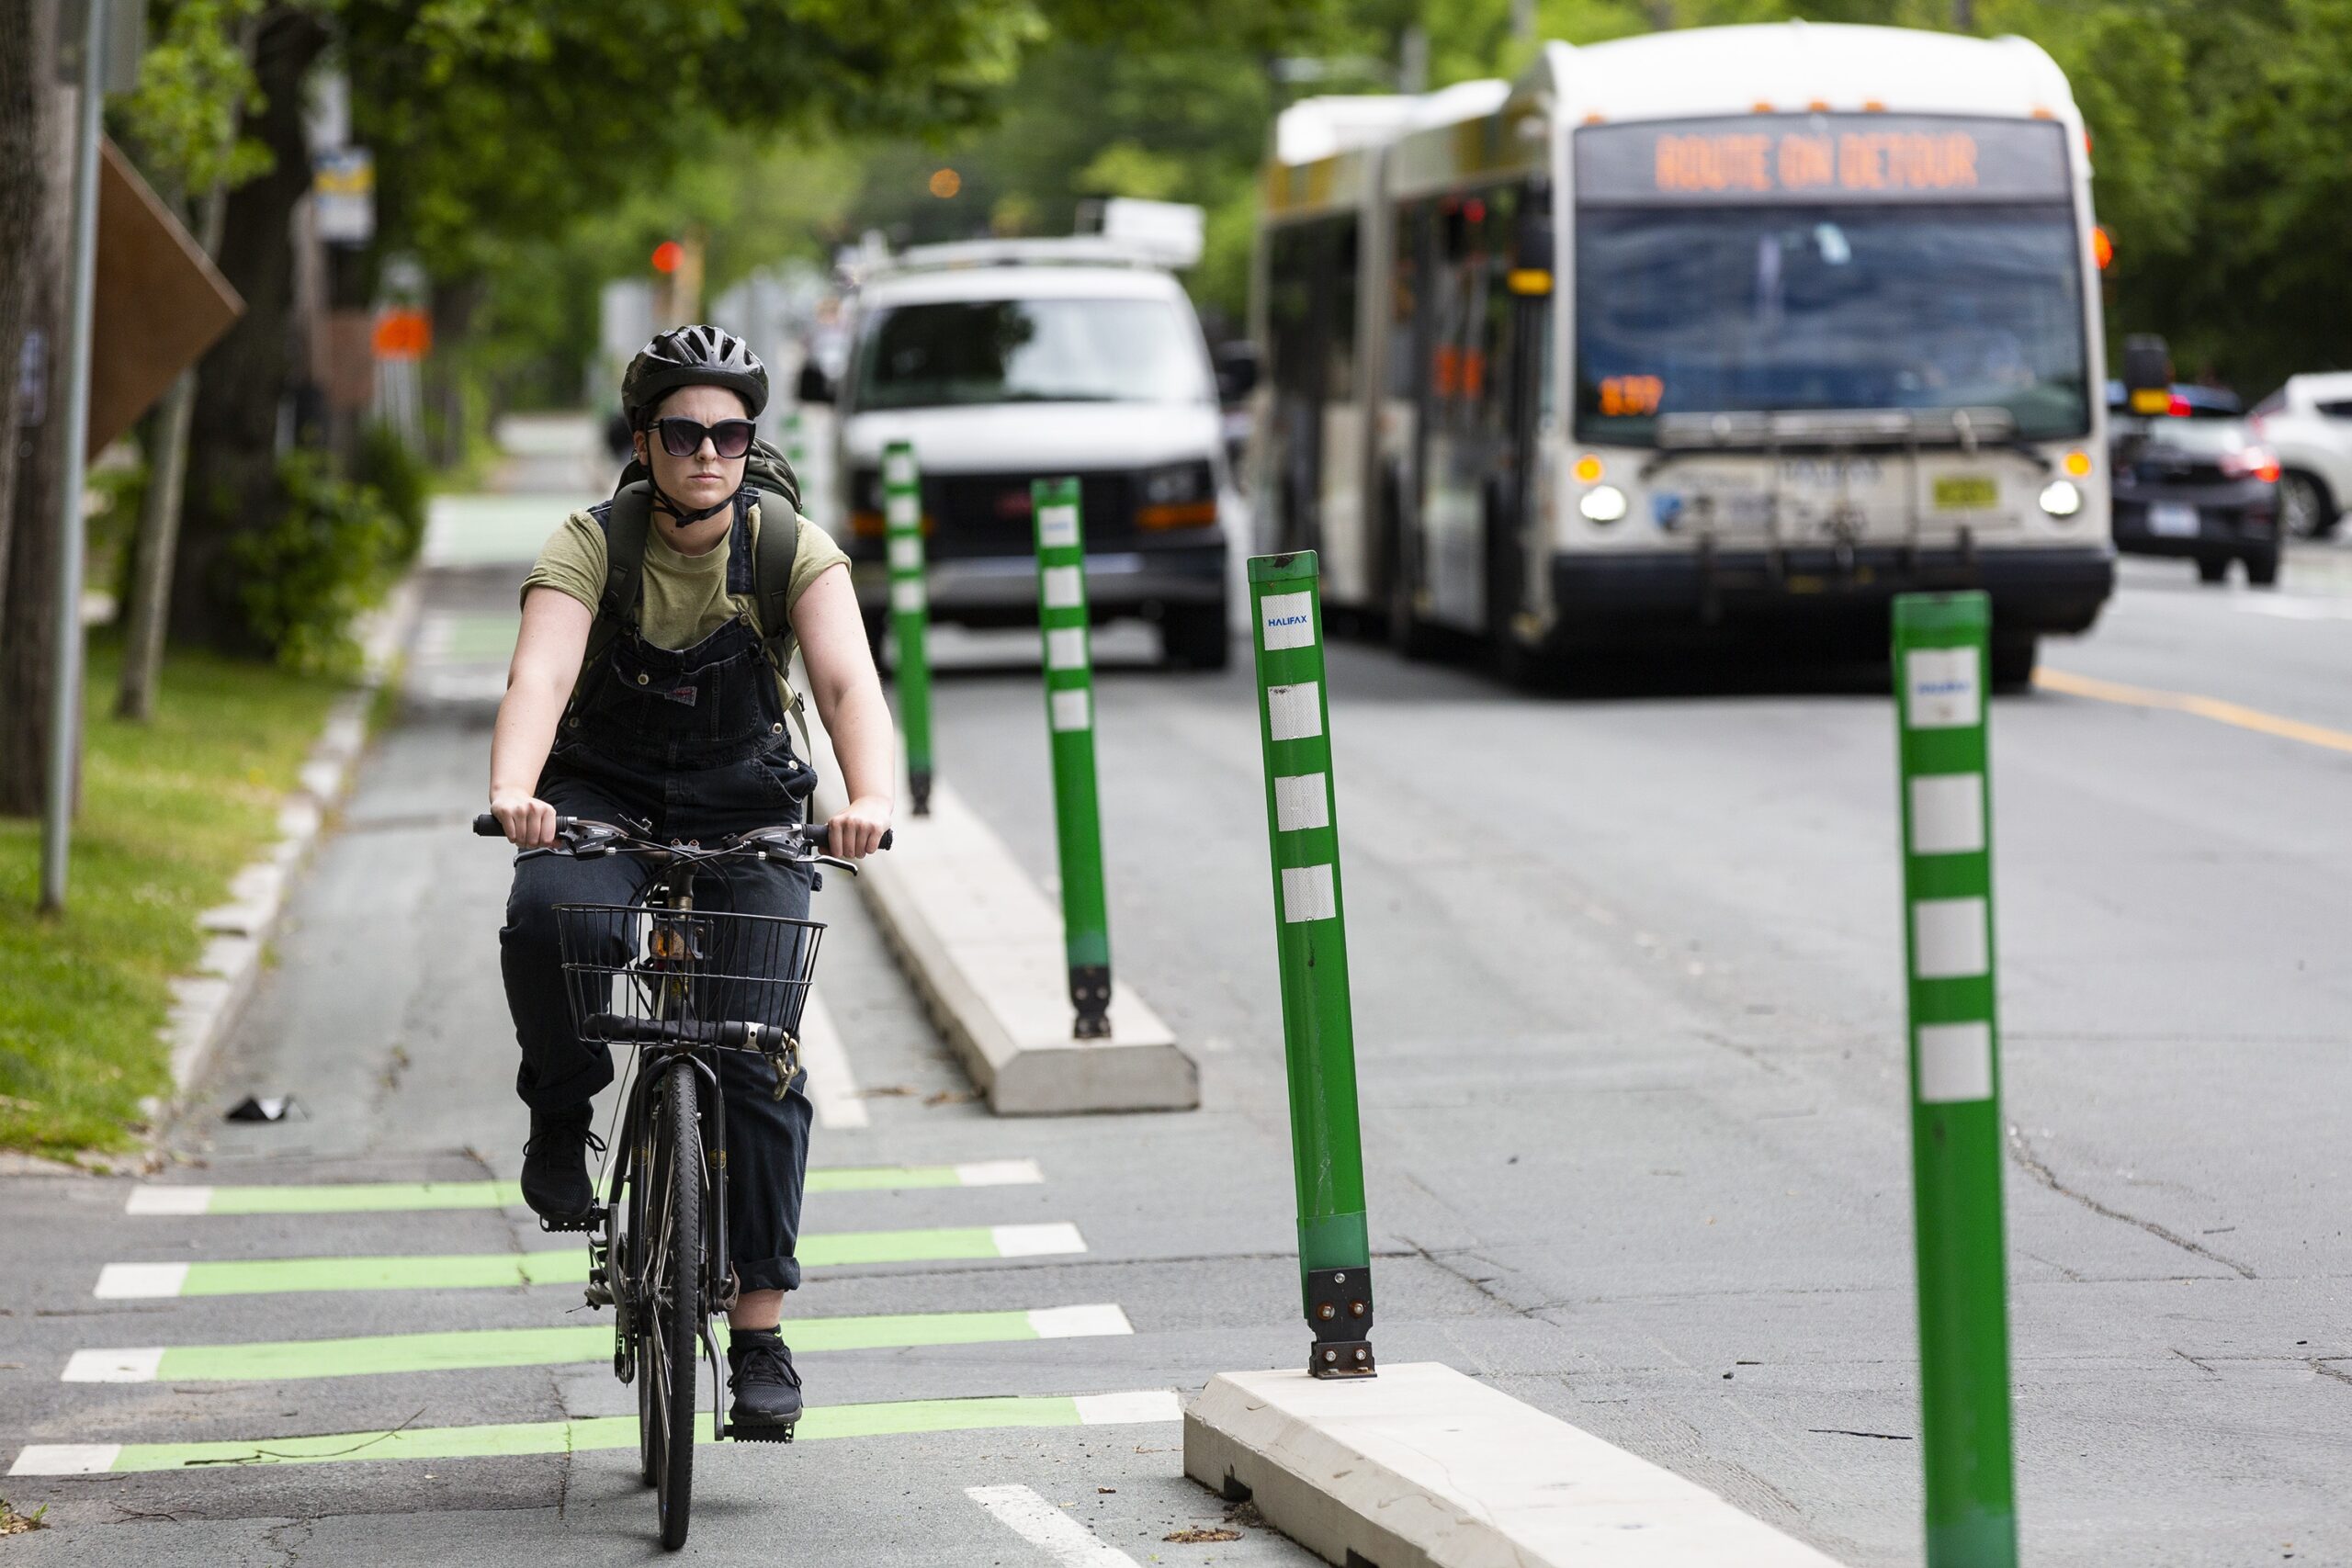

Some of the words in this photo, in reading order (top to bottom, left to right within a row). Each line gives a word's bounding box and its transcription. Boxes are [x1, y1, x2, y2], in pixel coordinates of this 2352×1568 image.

[1657, 133, 1772, 191] ROUTE
[1778, 132, 1834, 189] ON
[1839, 131, 1978, 188] DETOUR
[1268, 615, 1307, 626] HALIFAX
